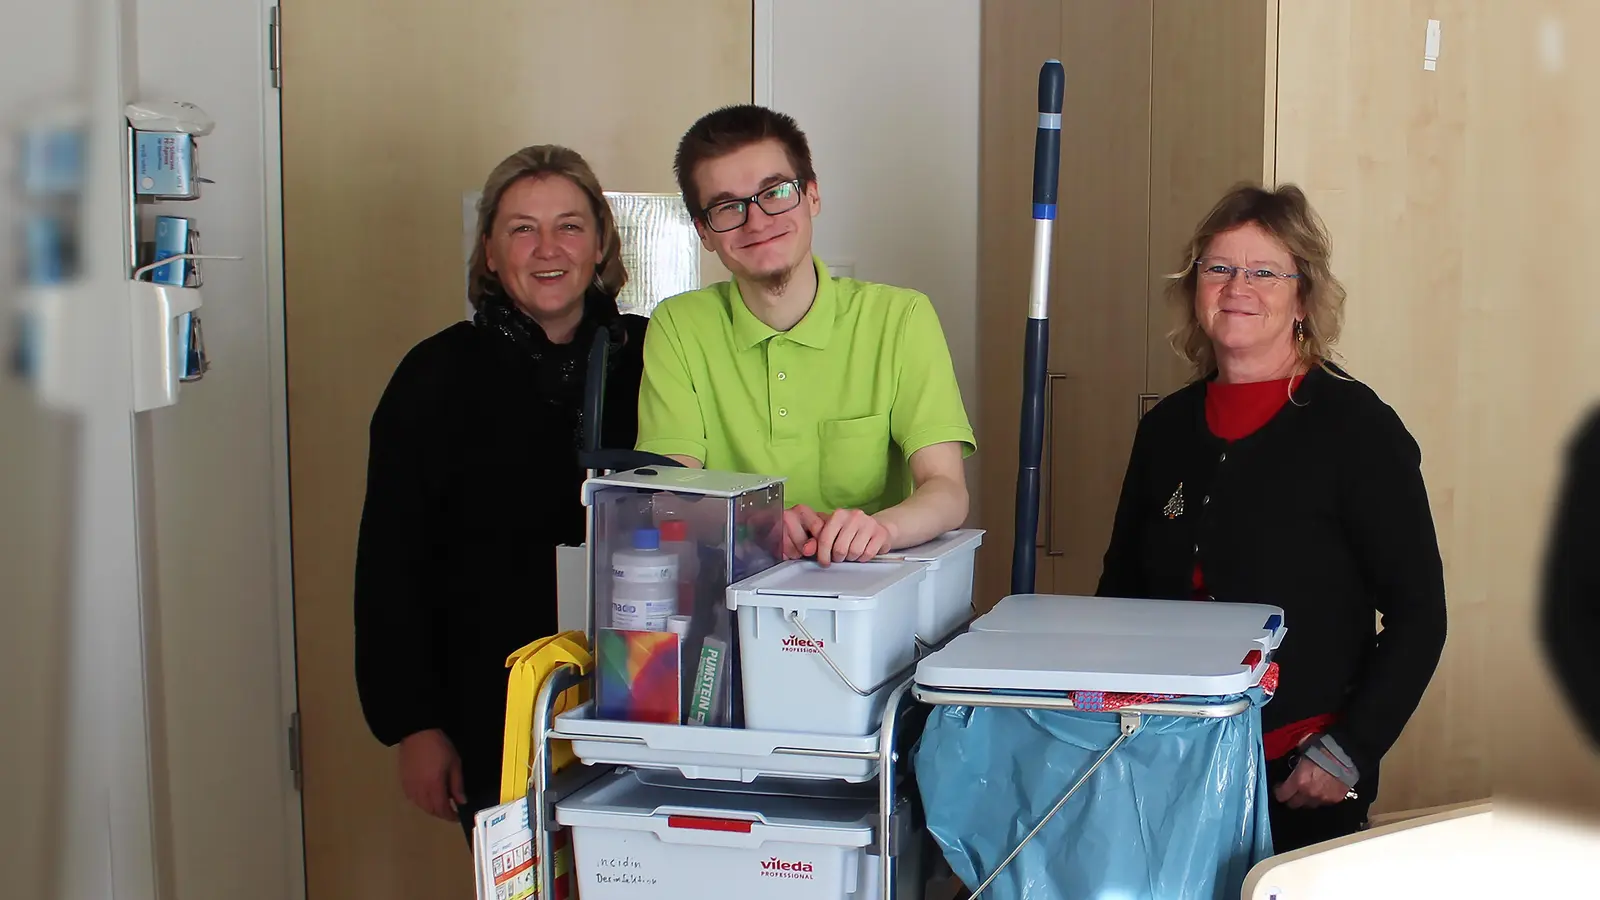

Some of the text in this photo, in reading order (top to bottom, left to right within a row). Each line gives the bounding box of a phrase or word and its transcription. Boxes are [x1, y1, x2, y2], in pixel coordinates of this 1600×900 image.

[698, 648, 719, 710] PUMSTEIN
[760, 856, 814, 873] vileda
[760, 871, 814, 880] PROFESSIONAL
